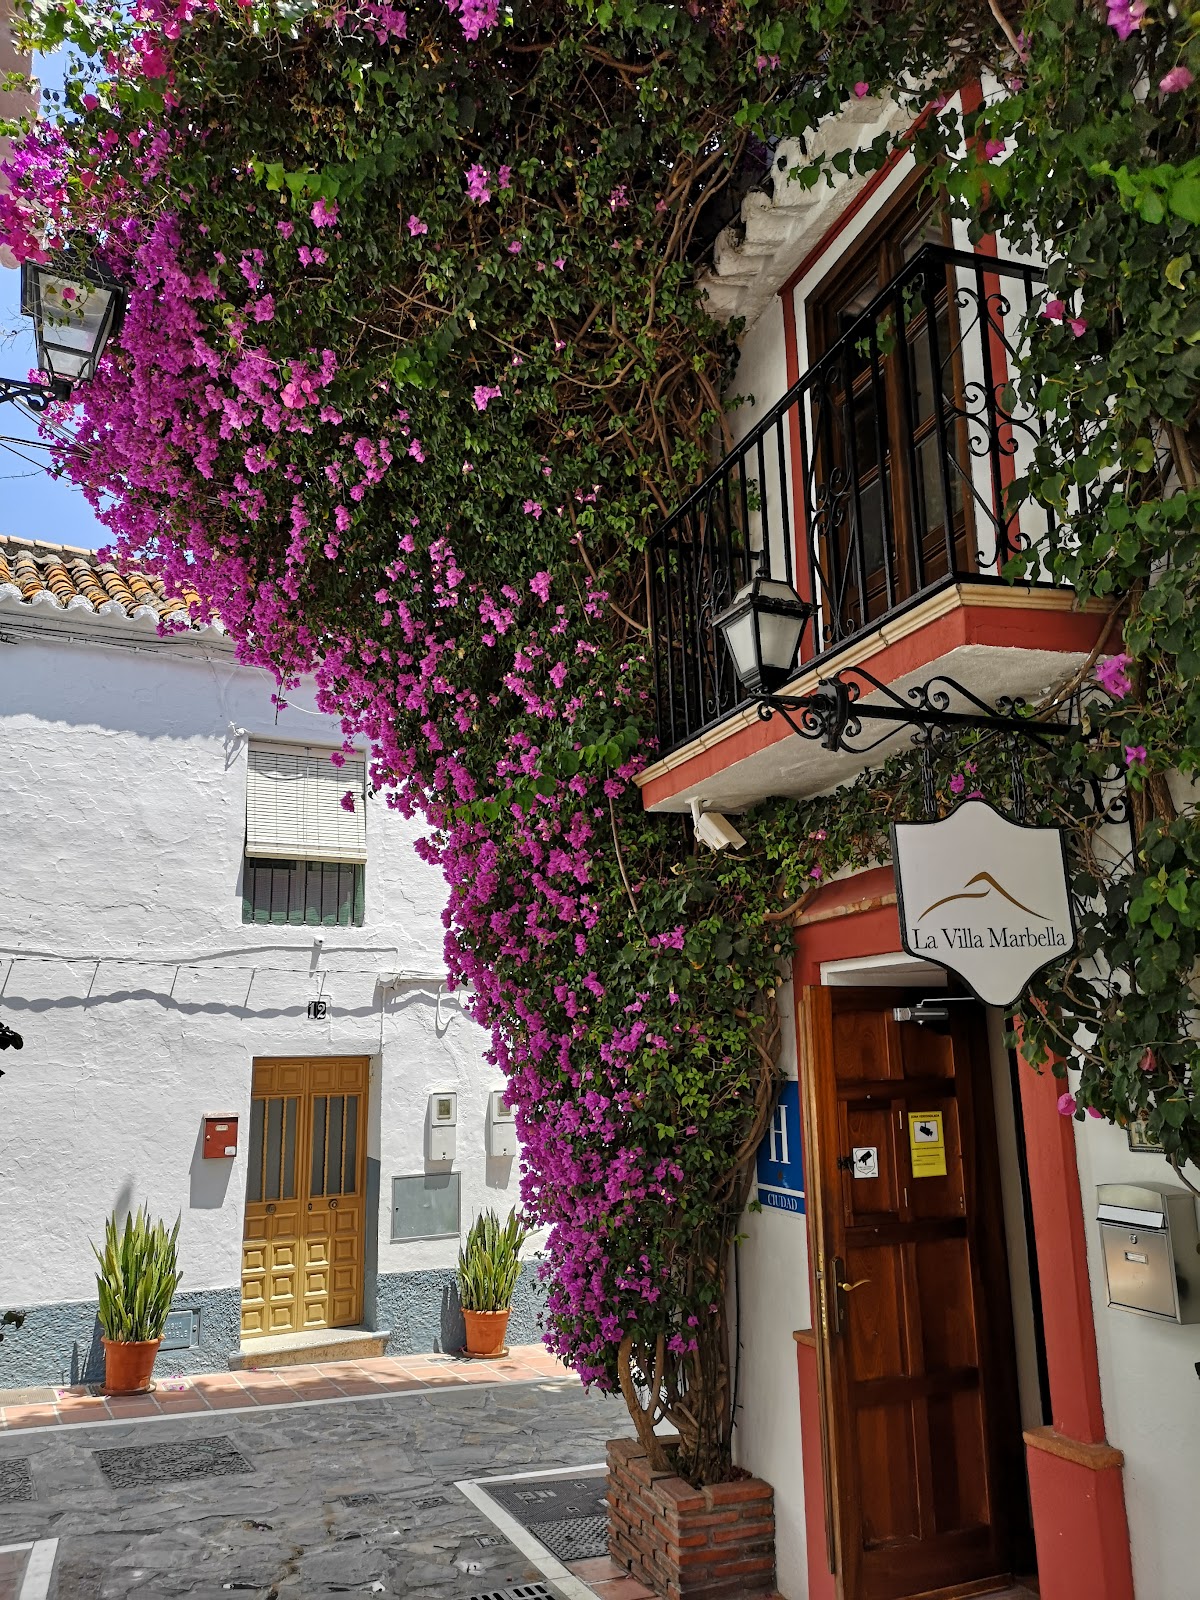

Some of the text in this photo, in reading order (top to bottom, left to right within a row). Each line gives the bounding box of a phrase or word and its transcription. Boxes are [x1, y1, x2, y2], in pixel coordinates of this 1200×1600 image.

[912, 926, 1067, 950] La Villa Marbella
[308, 1001, 326, 1019] 12
[769, 1104, 791, 1164] H
[767, 1193, 798, 1211] CIUDAD
